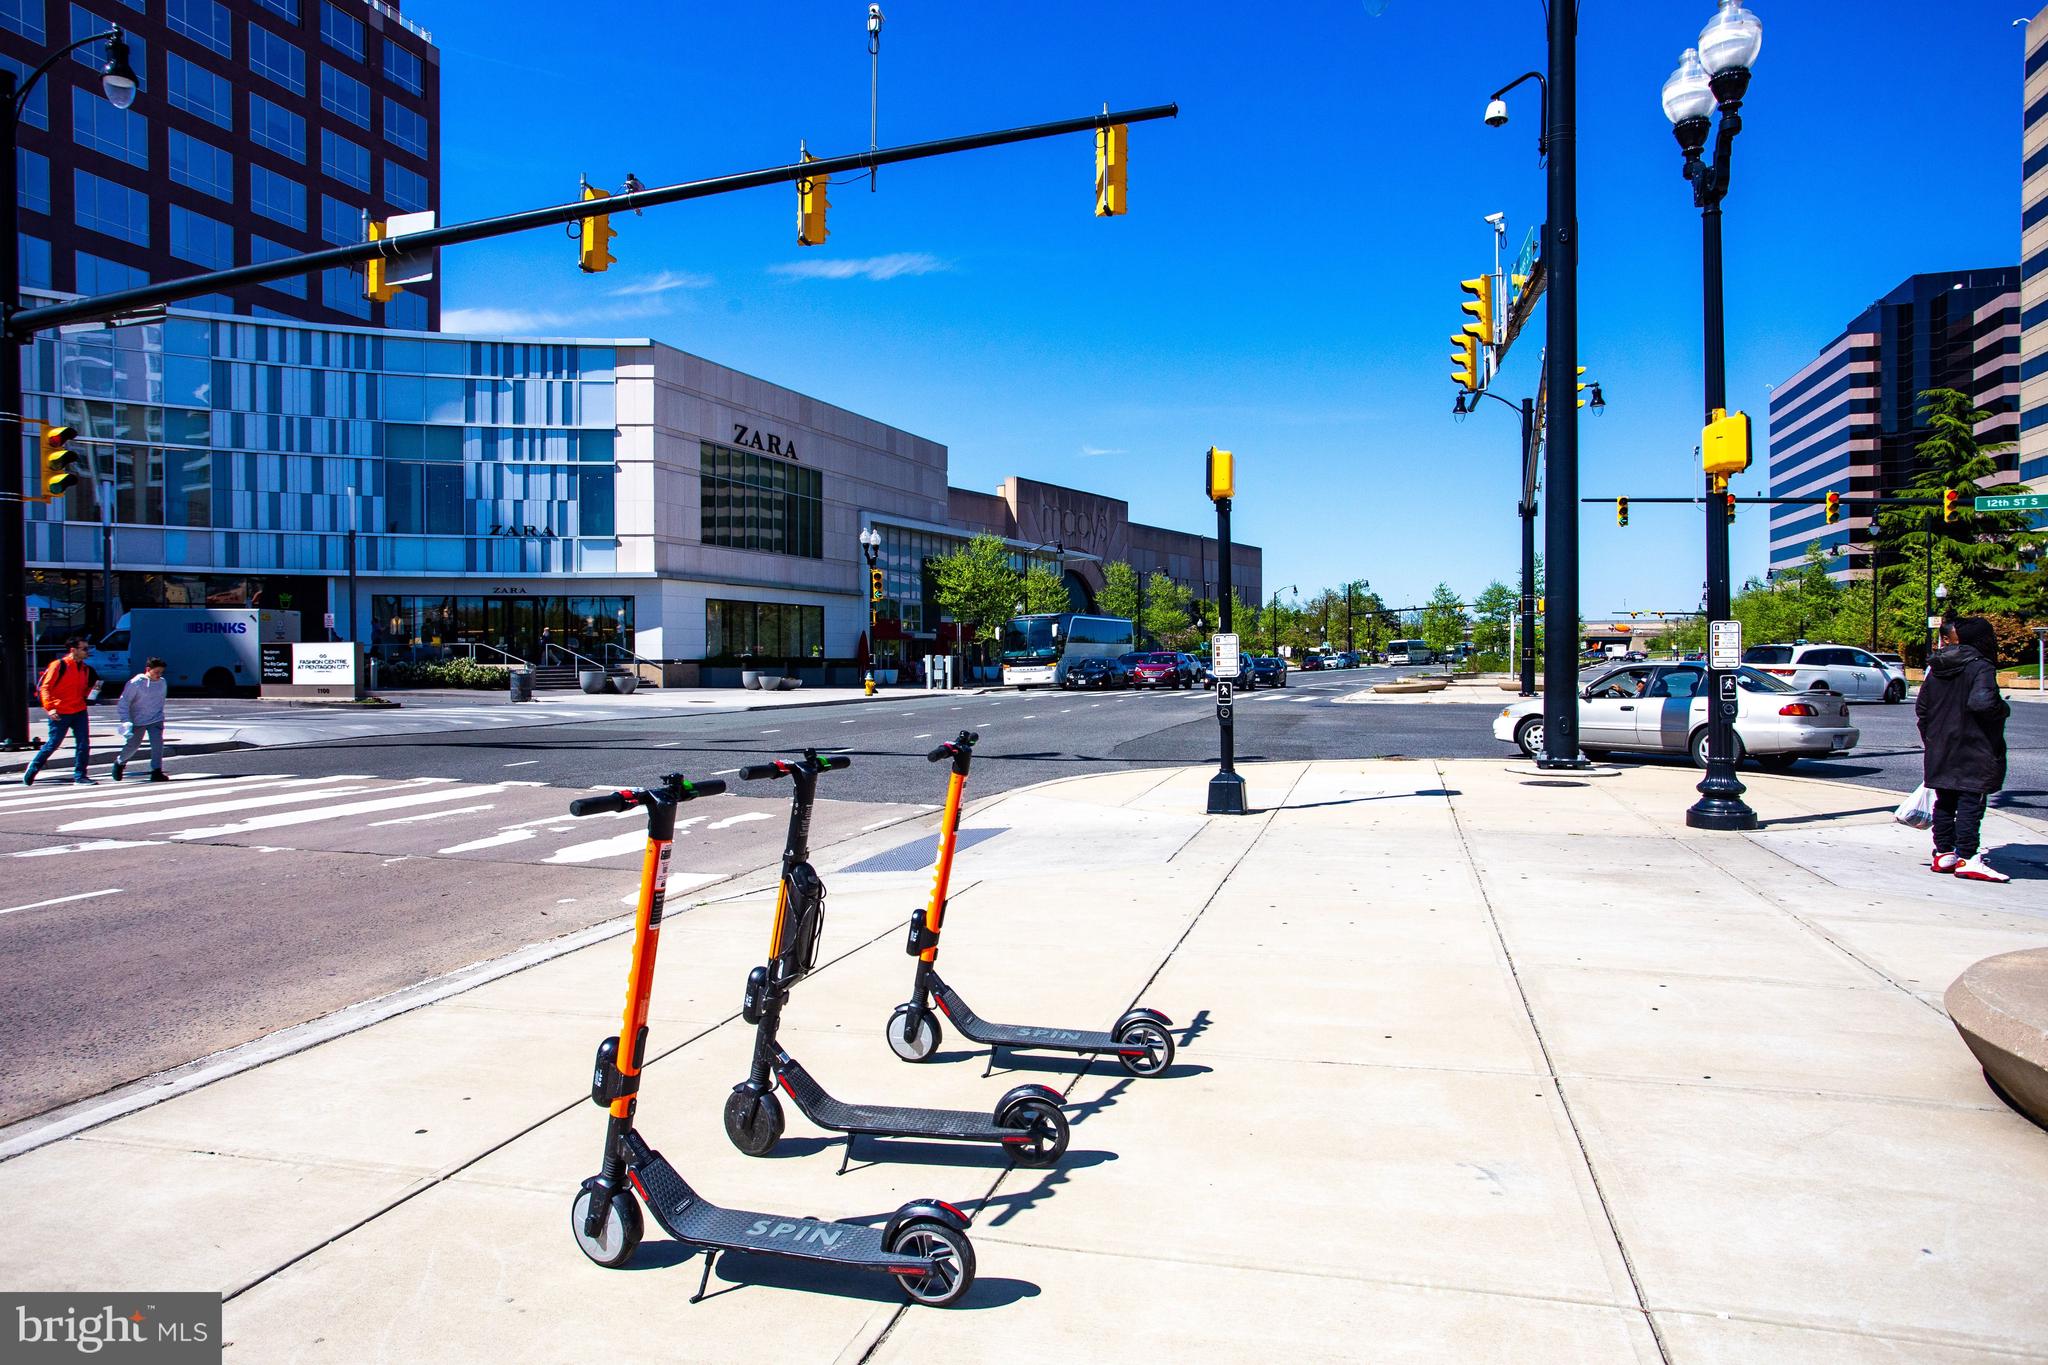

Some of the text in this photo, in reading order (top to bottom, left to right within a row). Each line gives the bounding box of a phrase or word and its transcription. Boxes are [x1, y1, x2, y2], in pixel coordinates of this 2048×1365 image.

[733, 423, 799, 460] ZARA
[1986, 497, 2039, 507] 12th ST S
[489, 524, 558, 538] ZARA
[193, 622, 247, 634] BRINKS
[1016, 1028, 1081, 1040] SPIN
[745, 1220, 844, 1246] SPIN
